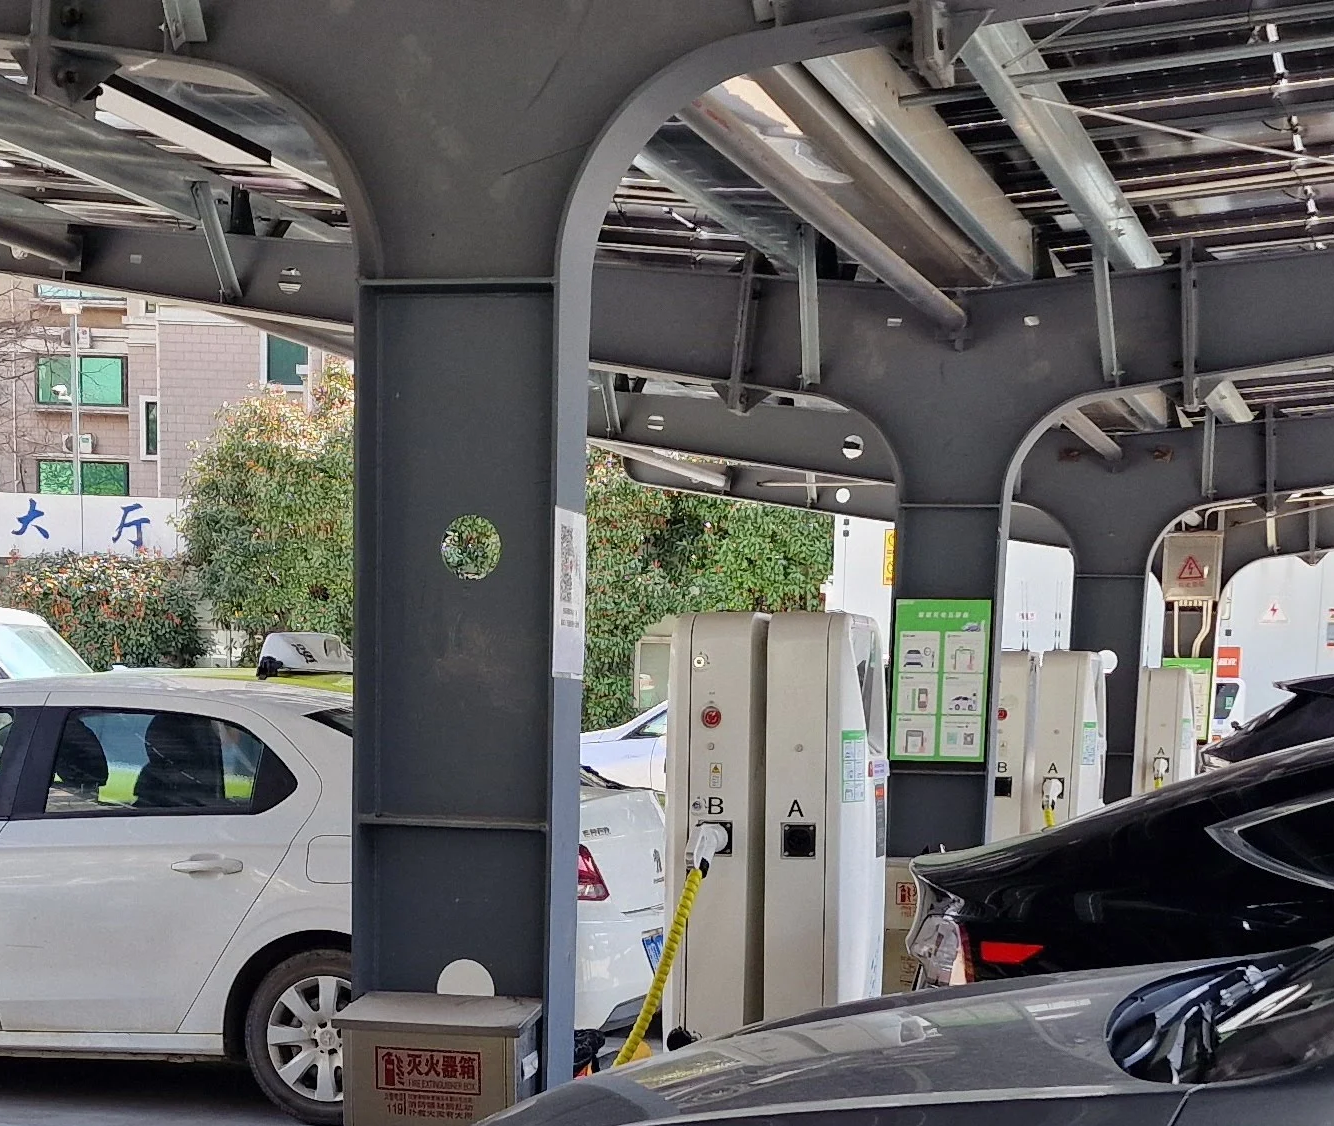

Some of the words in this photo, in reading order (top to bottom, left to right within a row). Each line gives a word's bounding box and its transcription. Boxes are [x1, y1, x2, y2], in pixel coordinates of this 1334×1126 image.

[1047, 763, 1058, 774] A
[707, 797, 724, 815] B
[787, 799, 805, 818] A
[407, 1053, 476, 1080] 灭火器箱
[387, 1102, 403, 1115] 119
